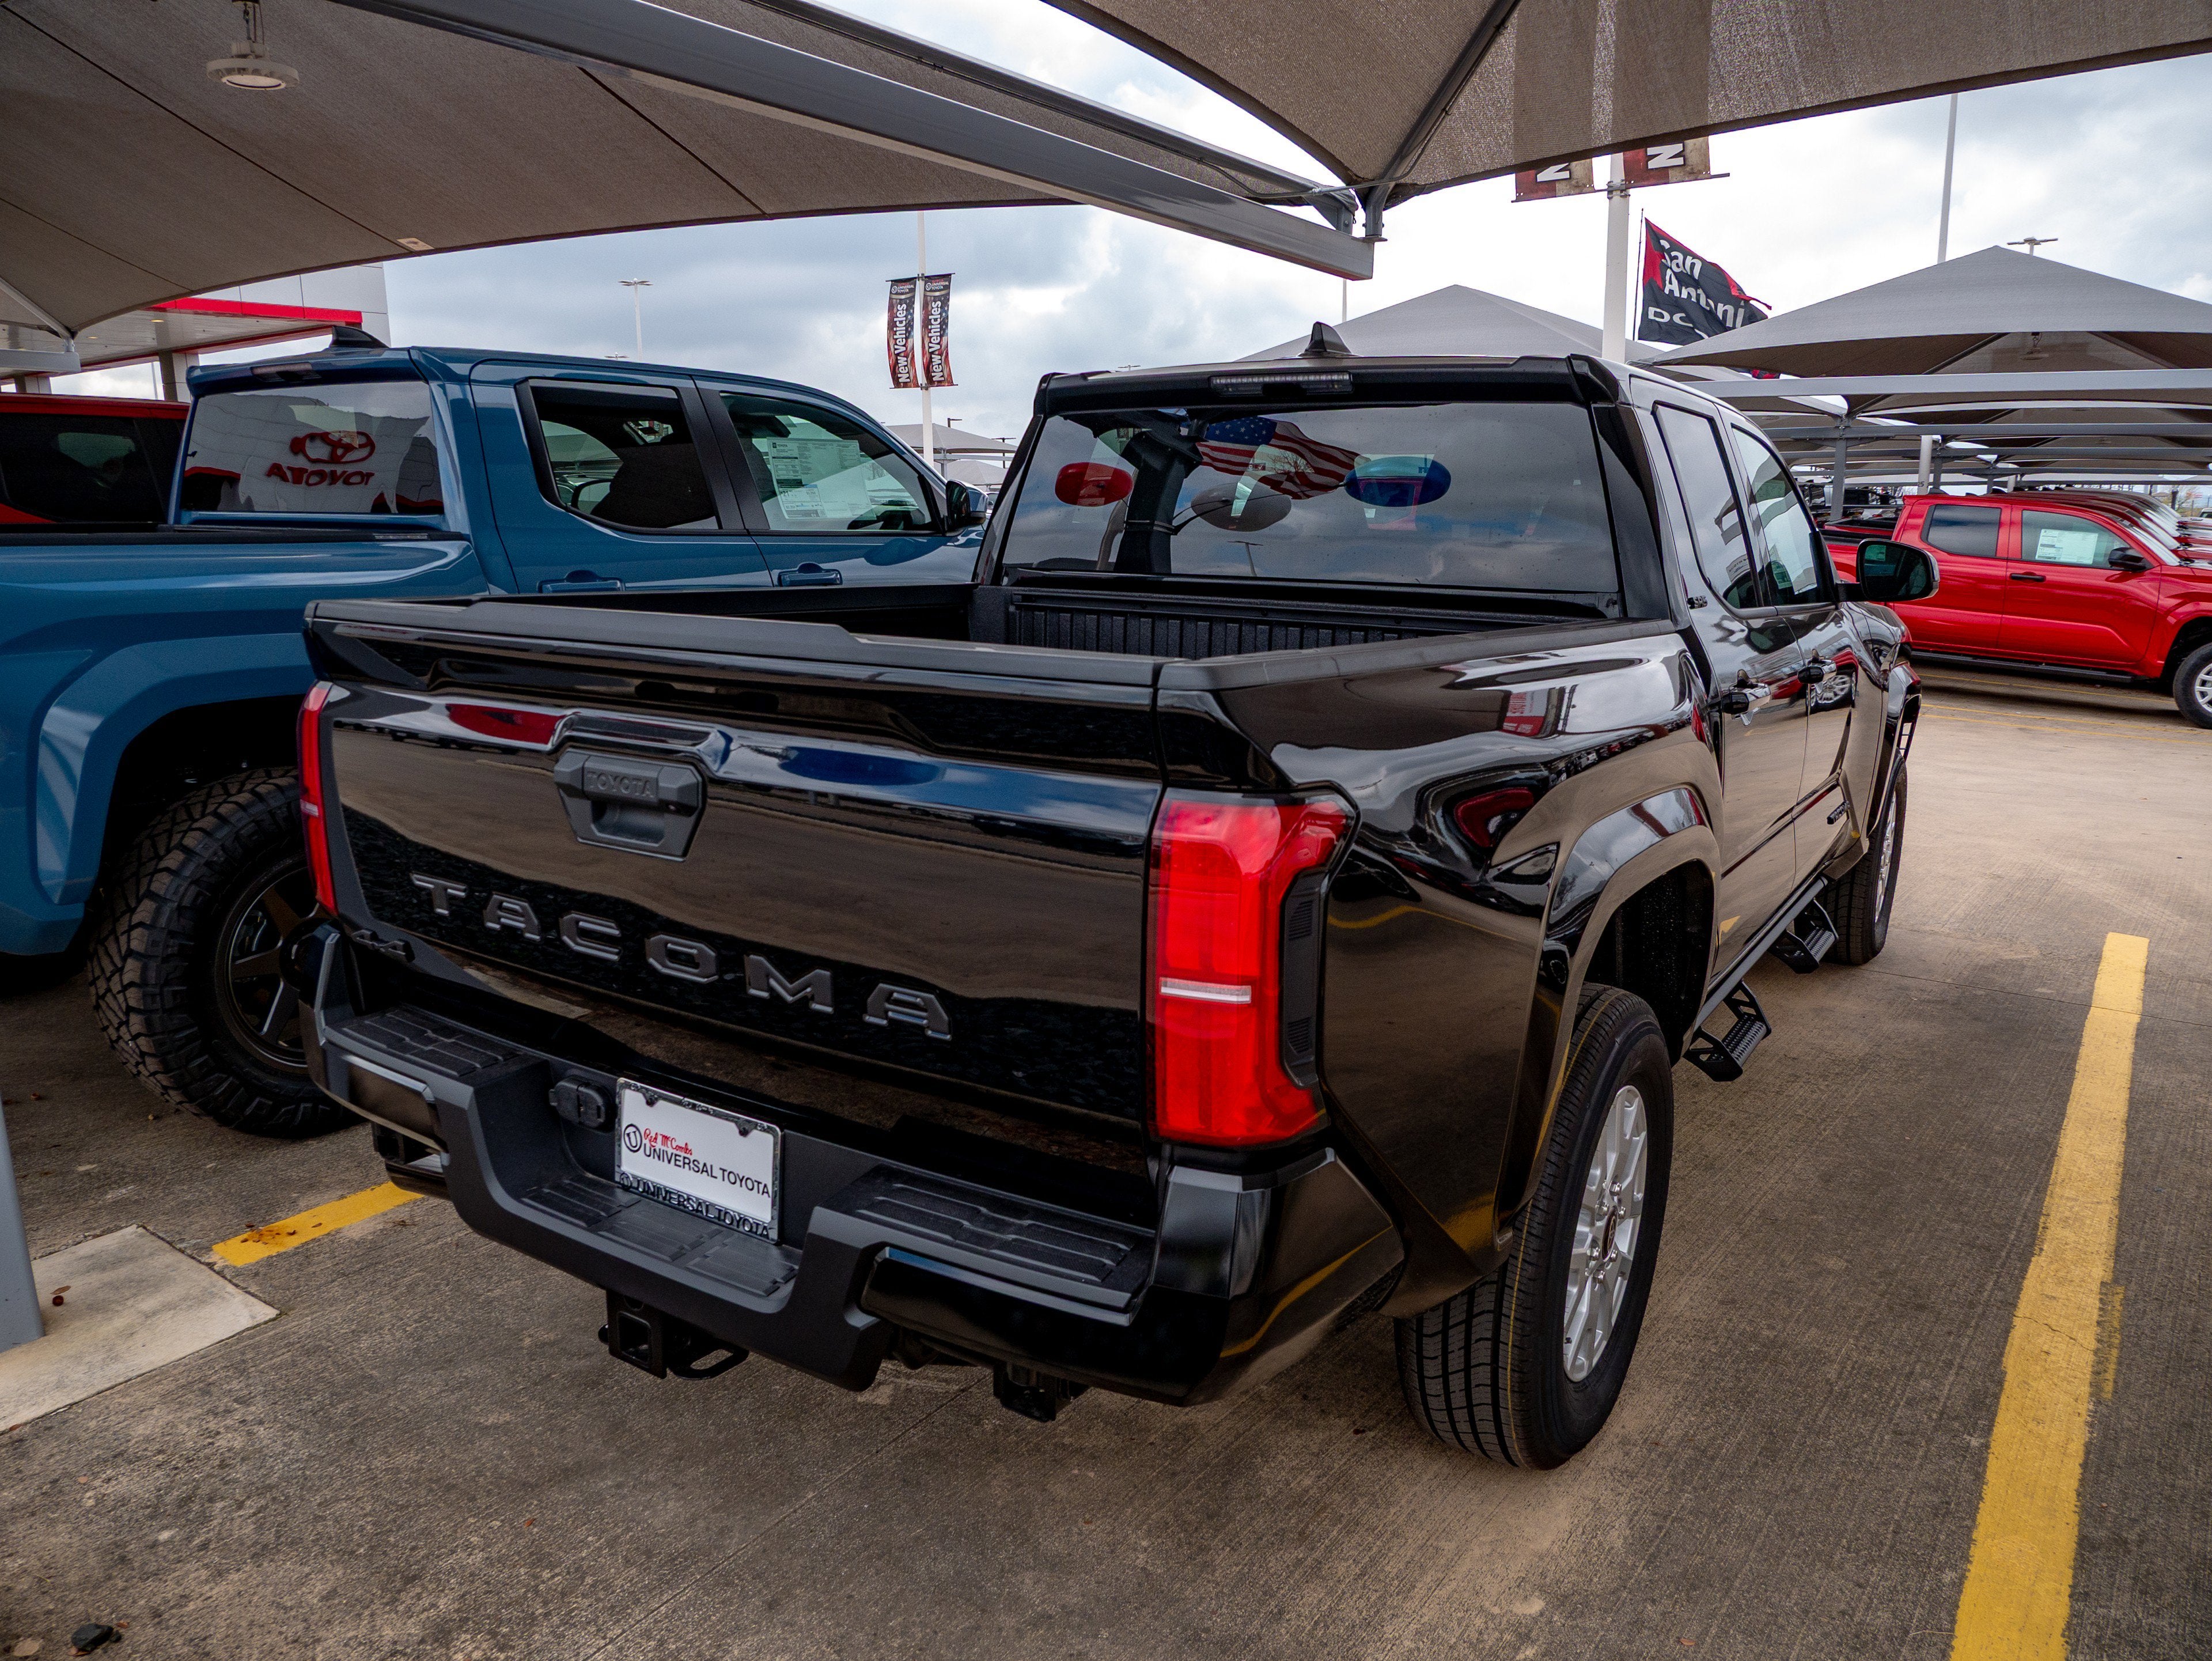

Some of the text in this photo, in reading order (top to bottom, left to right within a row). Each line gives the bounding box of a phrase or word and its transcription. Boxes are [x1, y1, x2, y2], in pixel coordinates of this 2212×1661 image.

[1660, 240, 1702, 280] San
[1664, 268, 1745, 328] Antni
[894, 303, 910, 383] New Vehicles
[929, 300, 944, 381] New Vehicles
[588, 771, 654, 798] TOYOTA
[410, 872, 952, 1039] TACOMA
[643, 1127, 658, 1149] Red
[643, 1142, 771, 1198] UNIVERSAL TOYOTA
[635, 1178, 715, 1219] UNIVERSAL
[714, 1205, 770, 1239] TOYOTA
